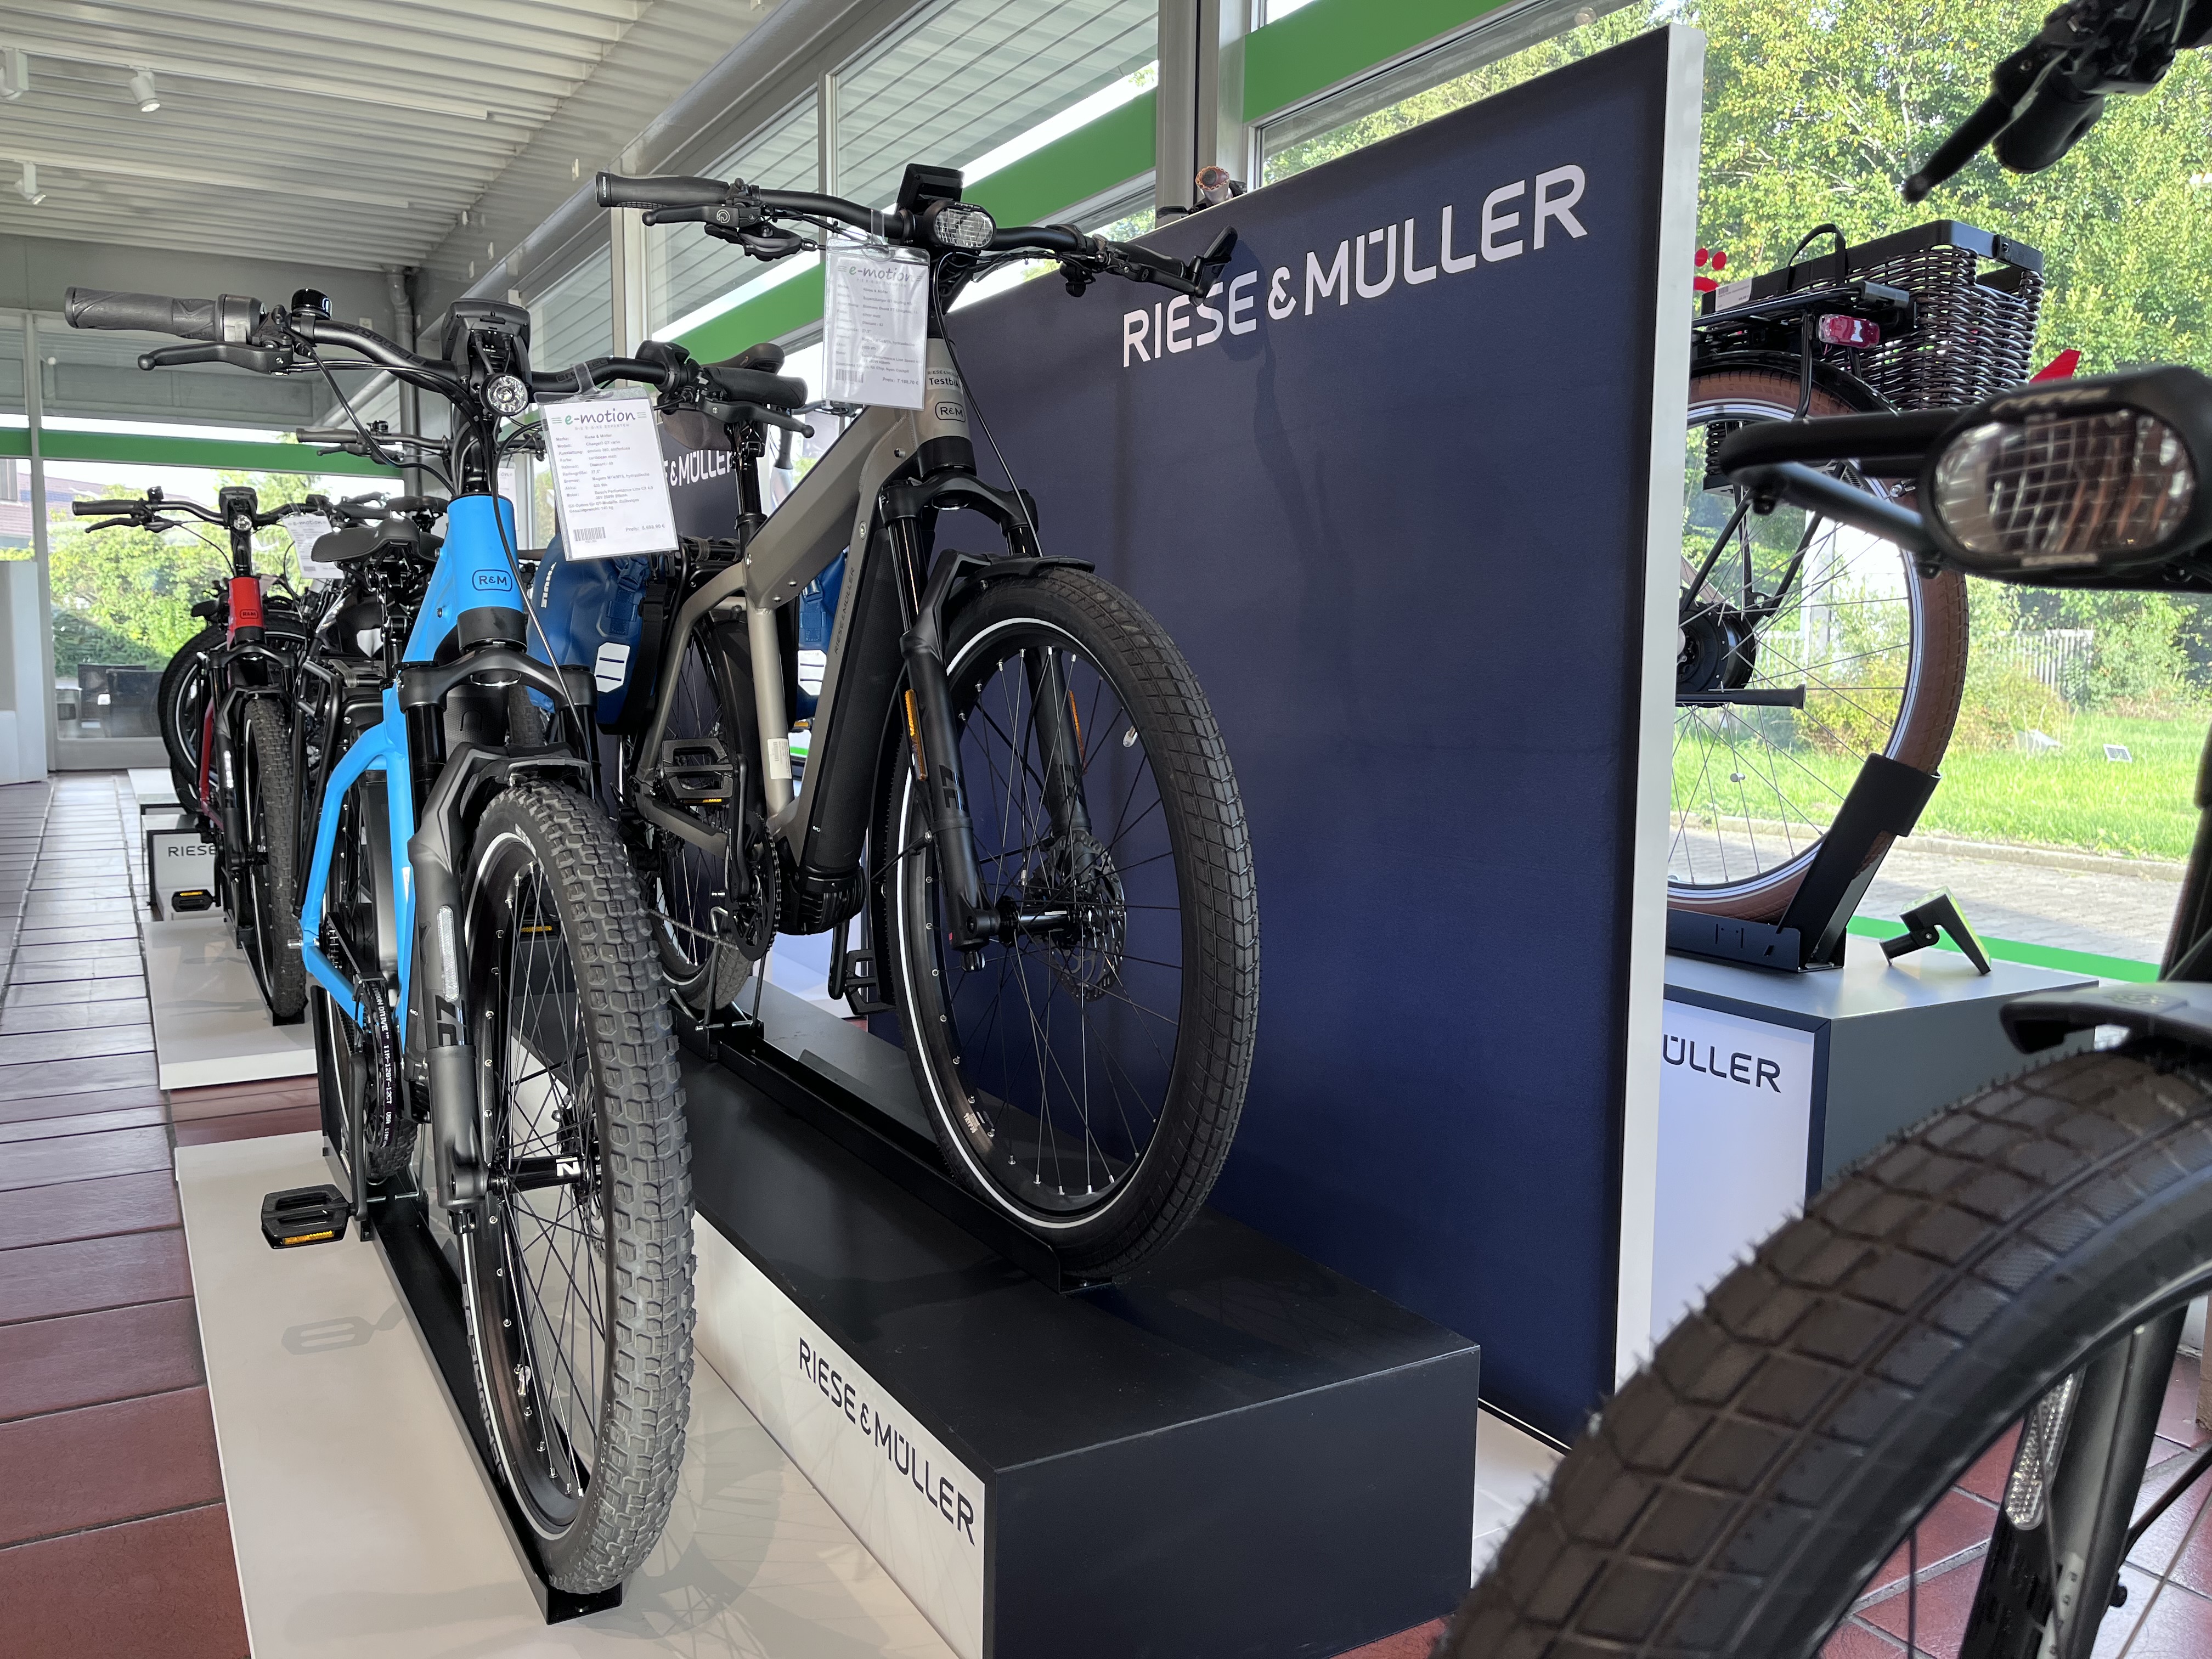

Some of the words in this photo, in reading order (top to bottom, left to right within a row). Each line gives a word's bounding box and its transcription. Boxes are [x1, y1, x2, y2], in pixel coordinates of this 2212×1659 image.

[1122, 270, 1258, 368] RIESE
[1267, 266, 1297, 321] &
[1304, 163, 1588, 317] MÜLLER
[929, 377, 960, 389] Testbik
[565, 408, 635, 425] e-motion
[479, 575, 507, 585] R&M
[541, 562, 557, 608] THULE
[834, 622, 844, 654] RIESE
[168, 845, 216, 857] RIESE
[1663, 1034, 1781, 1093] ÜLLER
[799, 1336, 856, 1425] RIESE
[860, 1402, 872, 1436] &
[874, 1410, 975, 1547] MÜLLER
